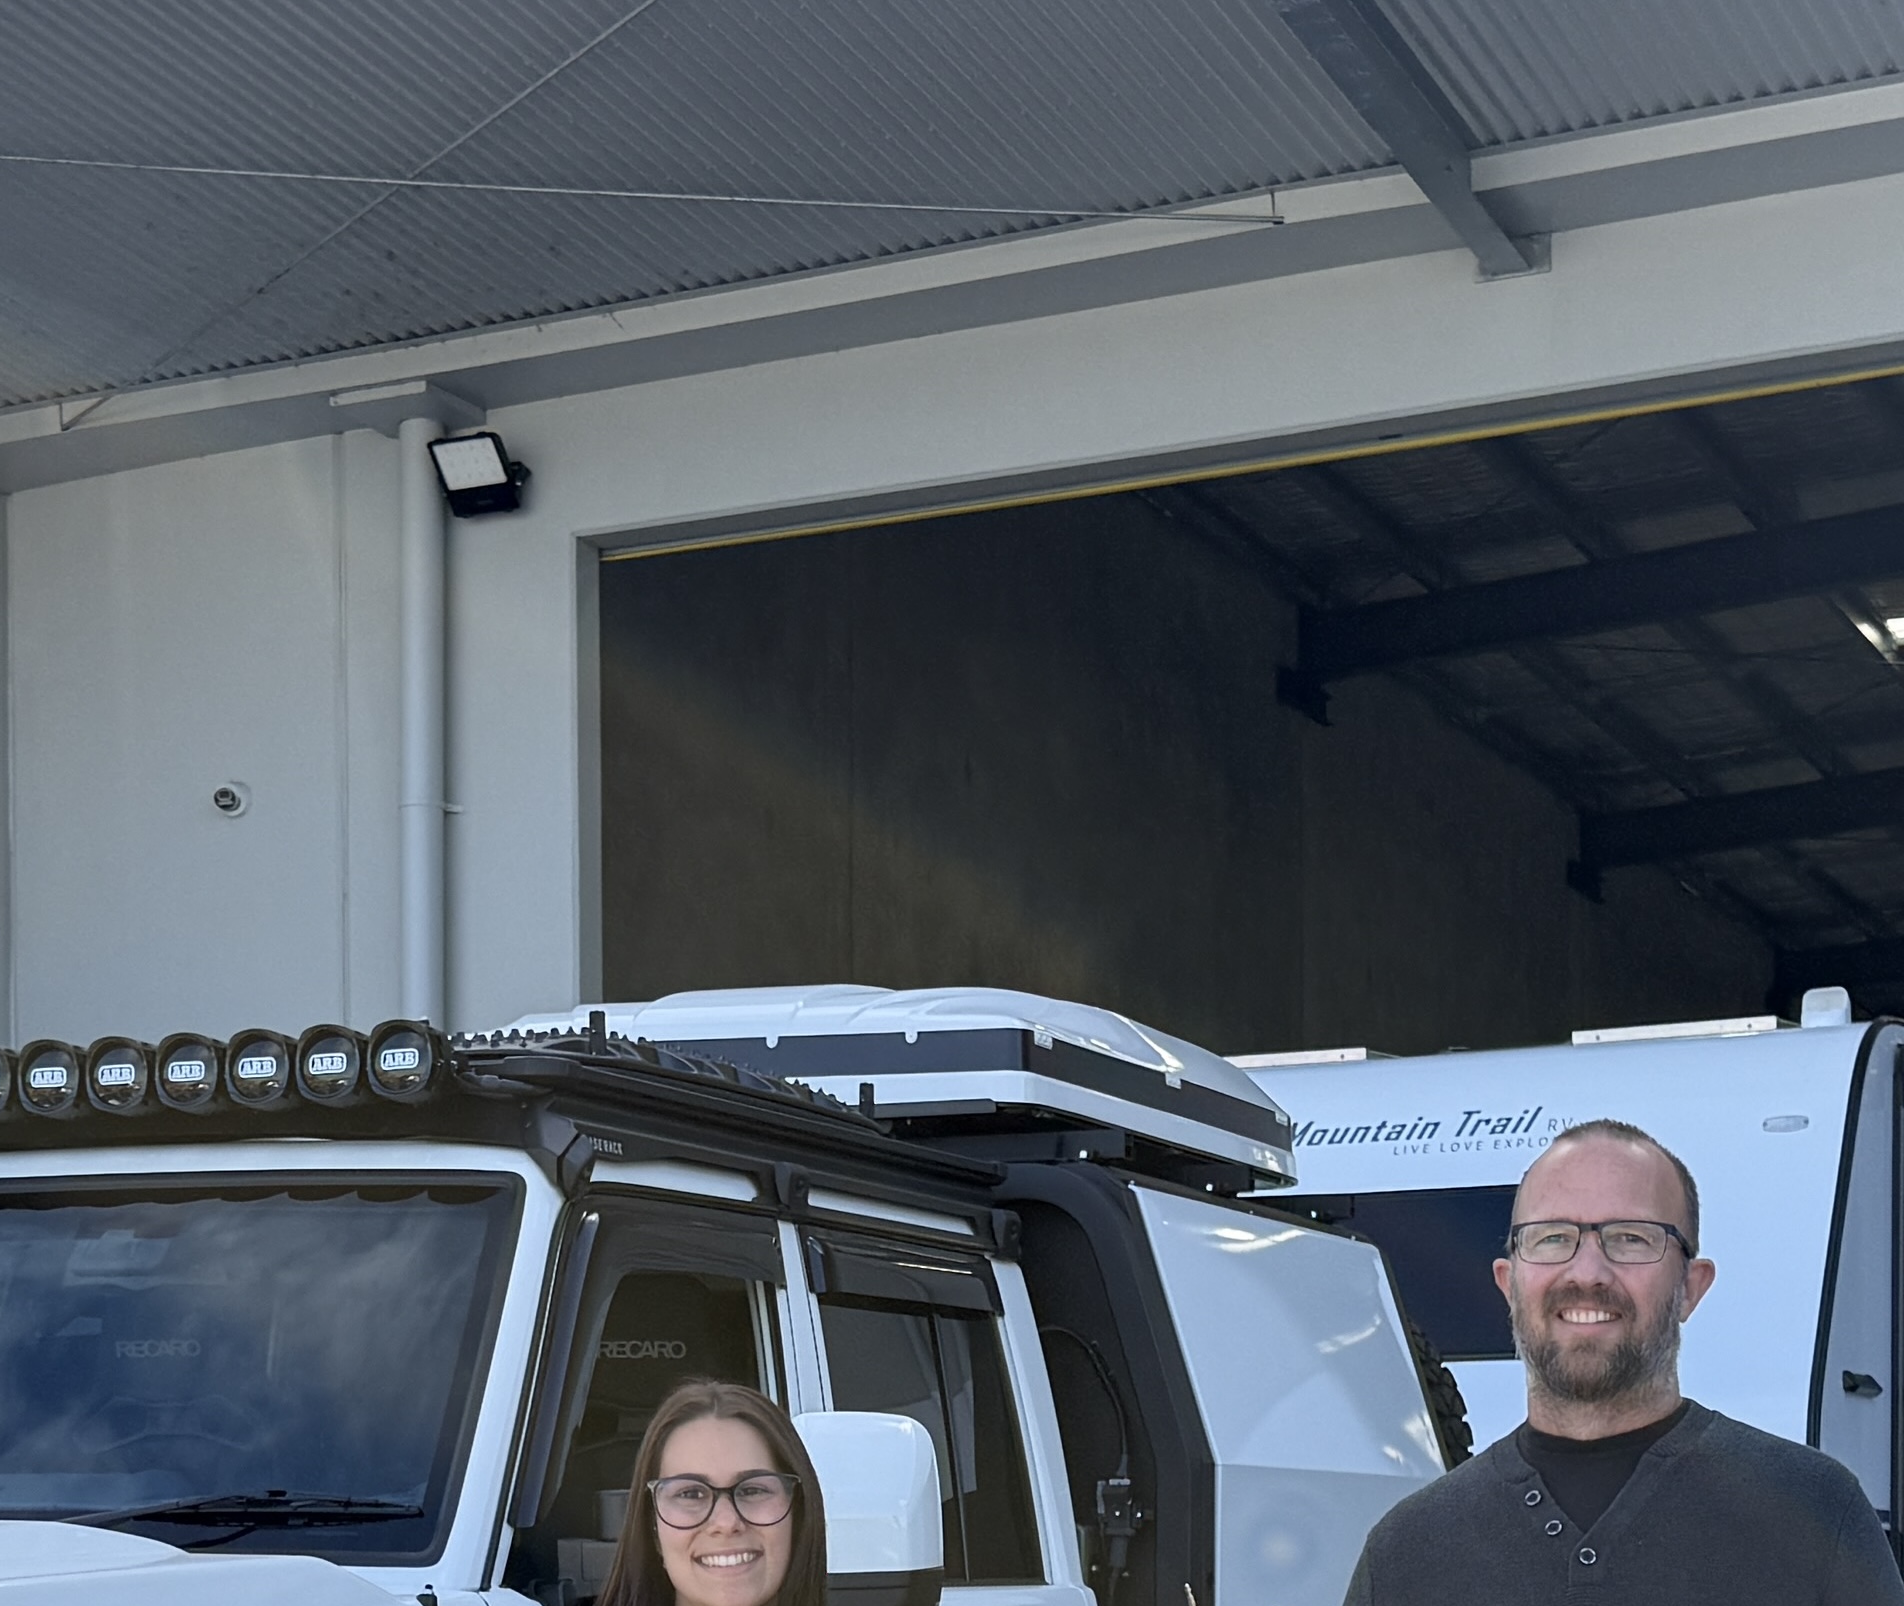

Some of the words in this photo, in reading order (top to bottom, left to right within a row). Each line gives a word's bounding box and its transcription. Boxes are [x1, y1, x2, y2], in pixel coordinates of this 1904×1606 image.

[1292, 1117, 1442, 1147] Mountain
[1455, 1106, 1543, 1138] Trail
[1393, 1144, 1430, 1156] LIVE
[1440, 1140, 1483, 1153] LOVE
[1494, 1136, 1549, 1149] EXPLO
[116, 1340, 201, 1358] RECARO
[599, 1340, 687, 1359] RECARO
